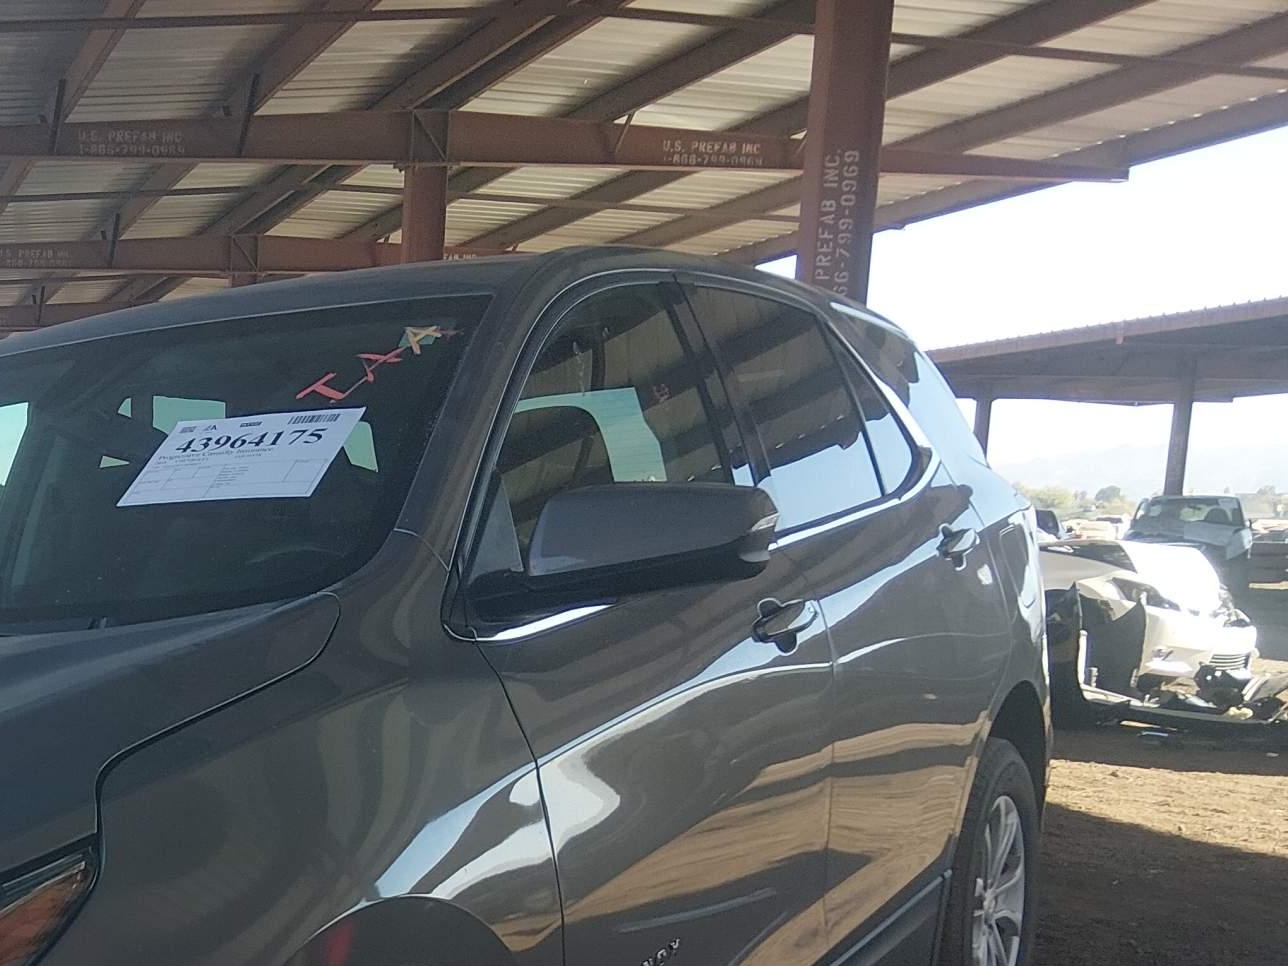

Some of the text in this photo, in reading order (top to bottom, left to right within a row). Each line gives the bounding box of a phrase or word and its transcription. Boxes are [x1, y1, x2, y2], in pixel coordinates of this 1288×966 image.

[662, 139, 685, 153] U.S.
[691, 141, 737, 154] PREFAB
[815, 199, 836, 279] PREFAB
[176, 427, 328, 453] 43964175
